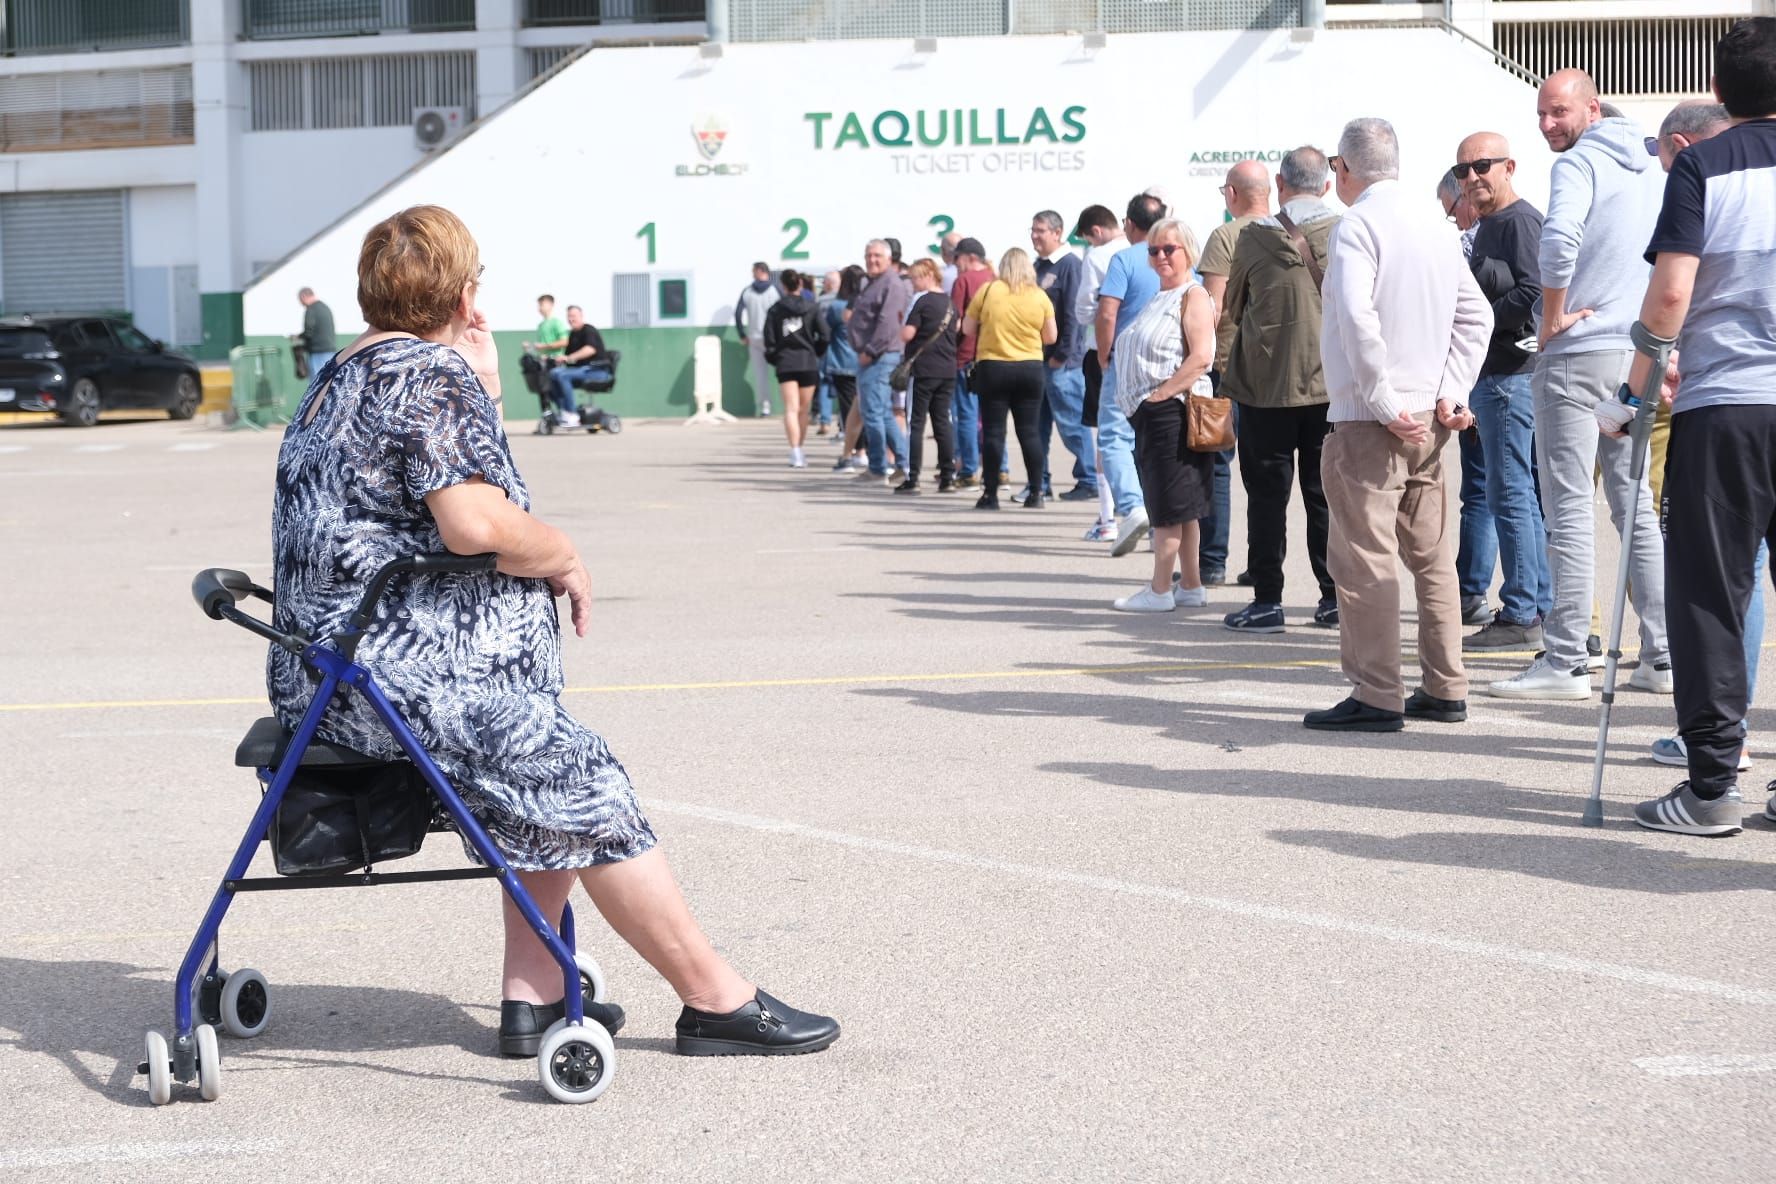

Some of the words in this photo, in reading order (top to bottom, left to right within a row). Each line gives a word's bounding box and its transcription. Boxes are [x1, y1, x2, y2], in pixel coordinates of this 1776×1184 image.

[804, 106, 1087, 149] TAQUILLAS
[891, 153, 976, 175] TICKET
[983, 150, 1086, 173] OFFICES
[636, 222, 656, 263] 1
[781, 218, 810, 259] 2
[927, 215, 955, 254] 3
